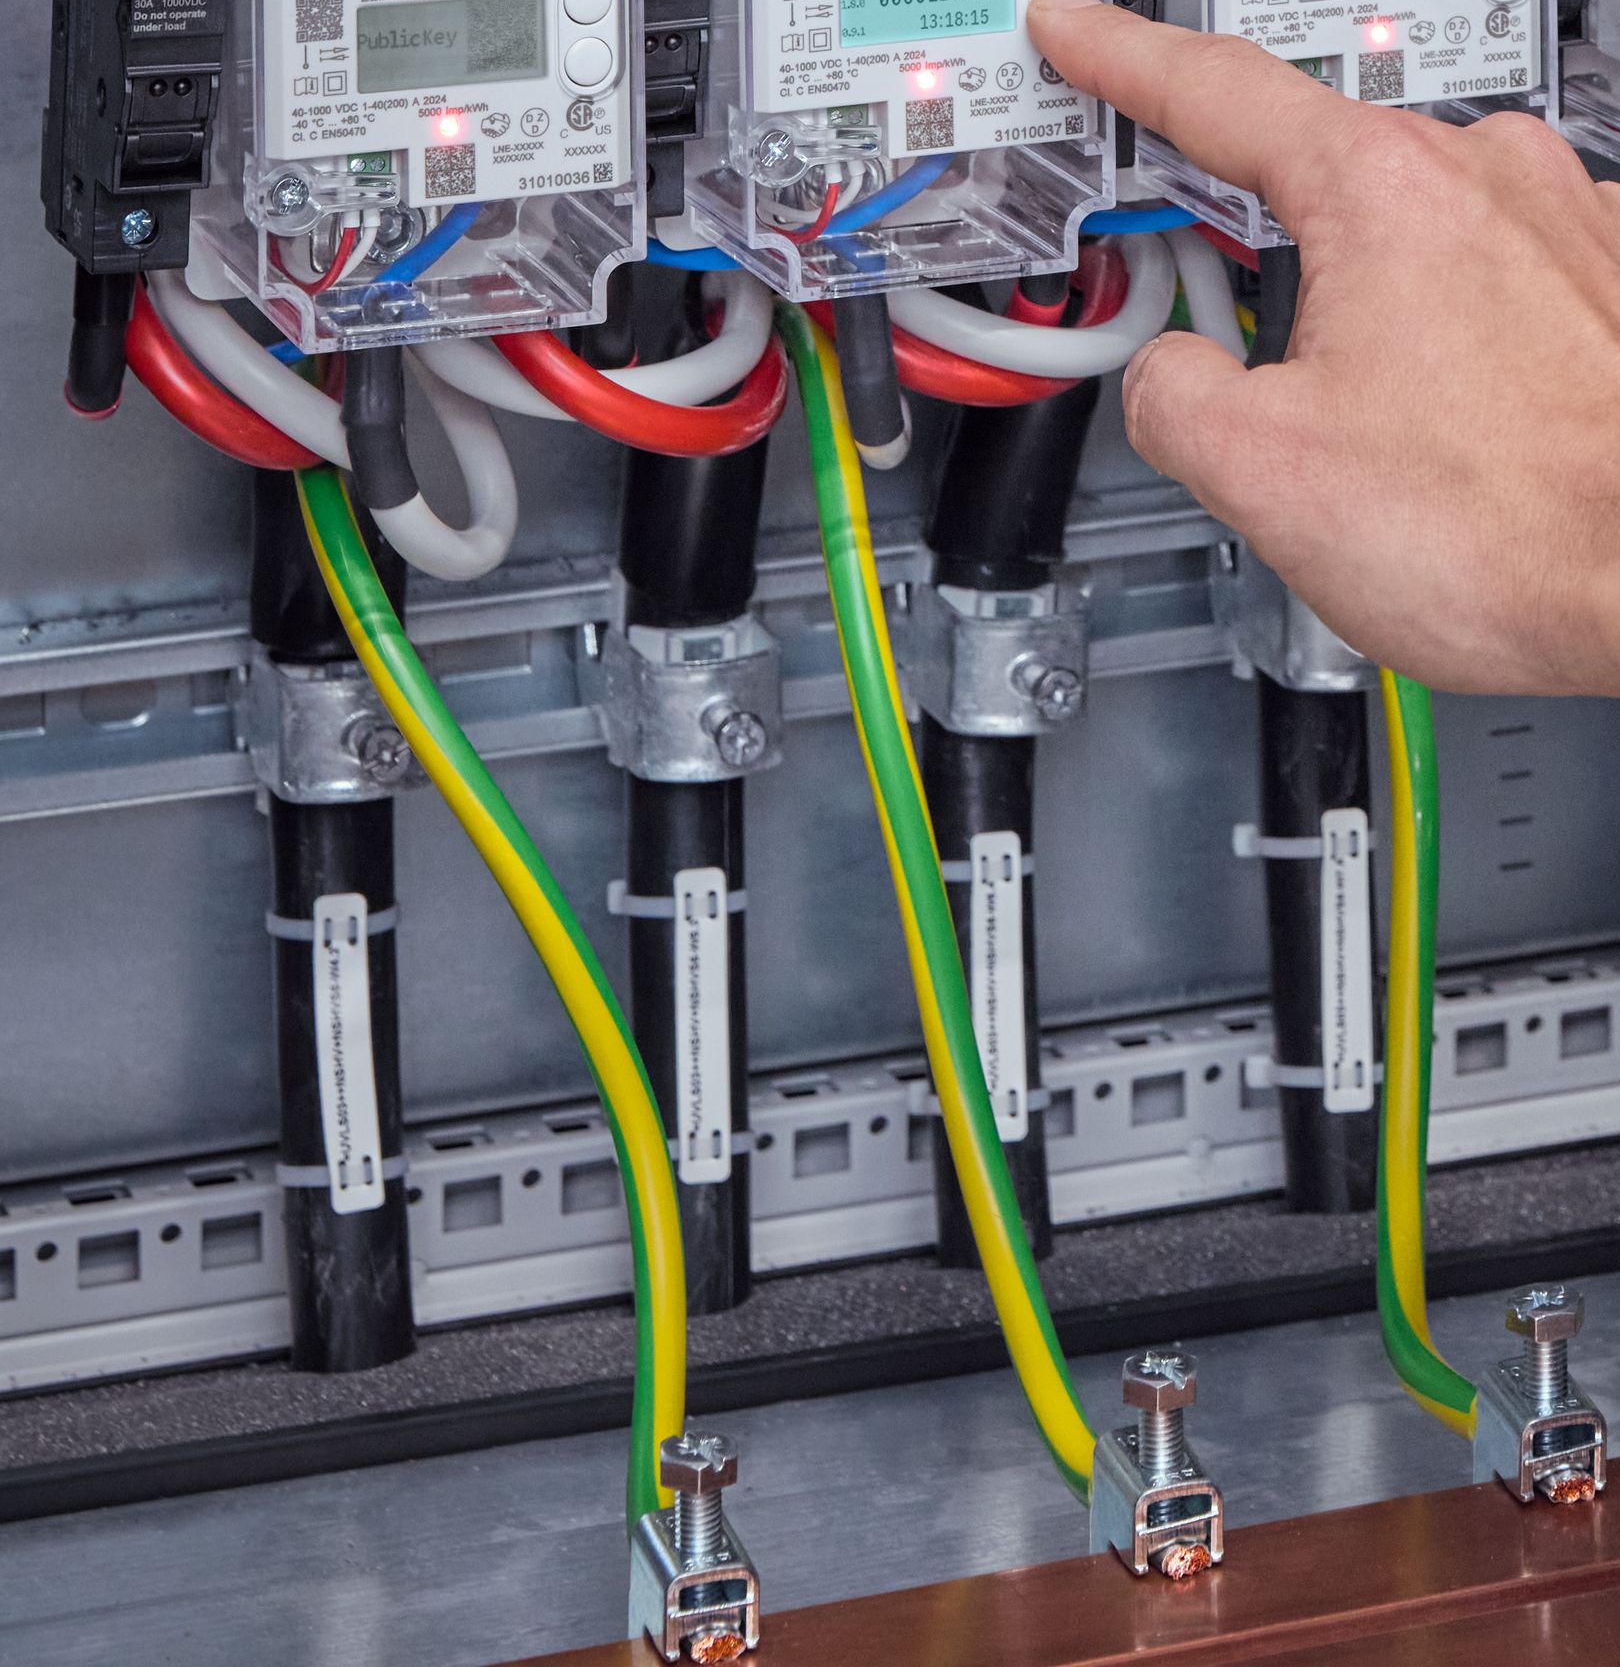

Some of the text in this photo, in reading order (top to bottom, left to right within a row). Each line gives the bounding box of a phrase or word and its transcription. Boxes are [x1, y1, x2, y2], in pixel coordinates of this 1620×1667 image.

[135, 0, 153, 8] 30A
[134, 10, 206, 20] Do not operate
[134, 20, 186, 32] under load
[842, 9, 989, 38] 0.9.1 13:18:15
[357, 31, 457, 50] PublicKey
[1443, 77, 1506, 93] 31010039
[292, 95, 446, 117] 40-1000 VDC 1-40(200) A 2024
[418, 107, 442, 117] 5000
[322, 127, 366, 139] EN50470
[995, 123, 1061, 141] 31010037
[519, 173, 590, 190] 31010036
